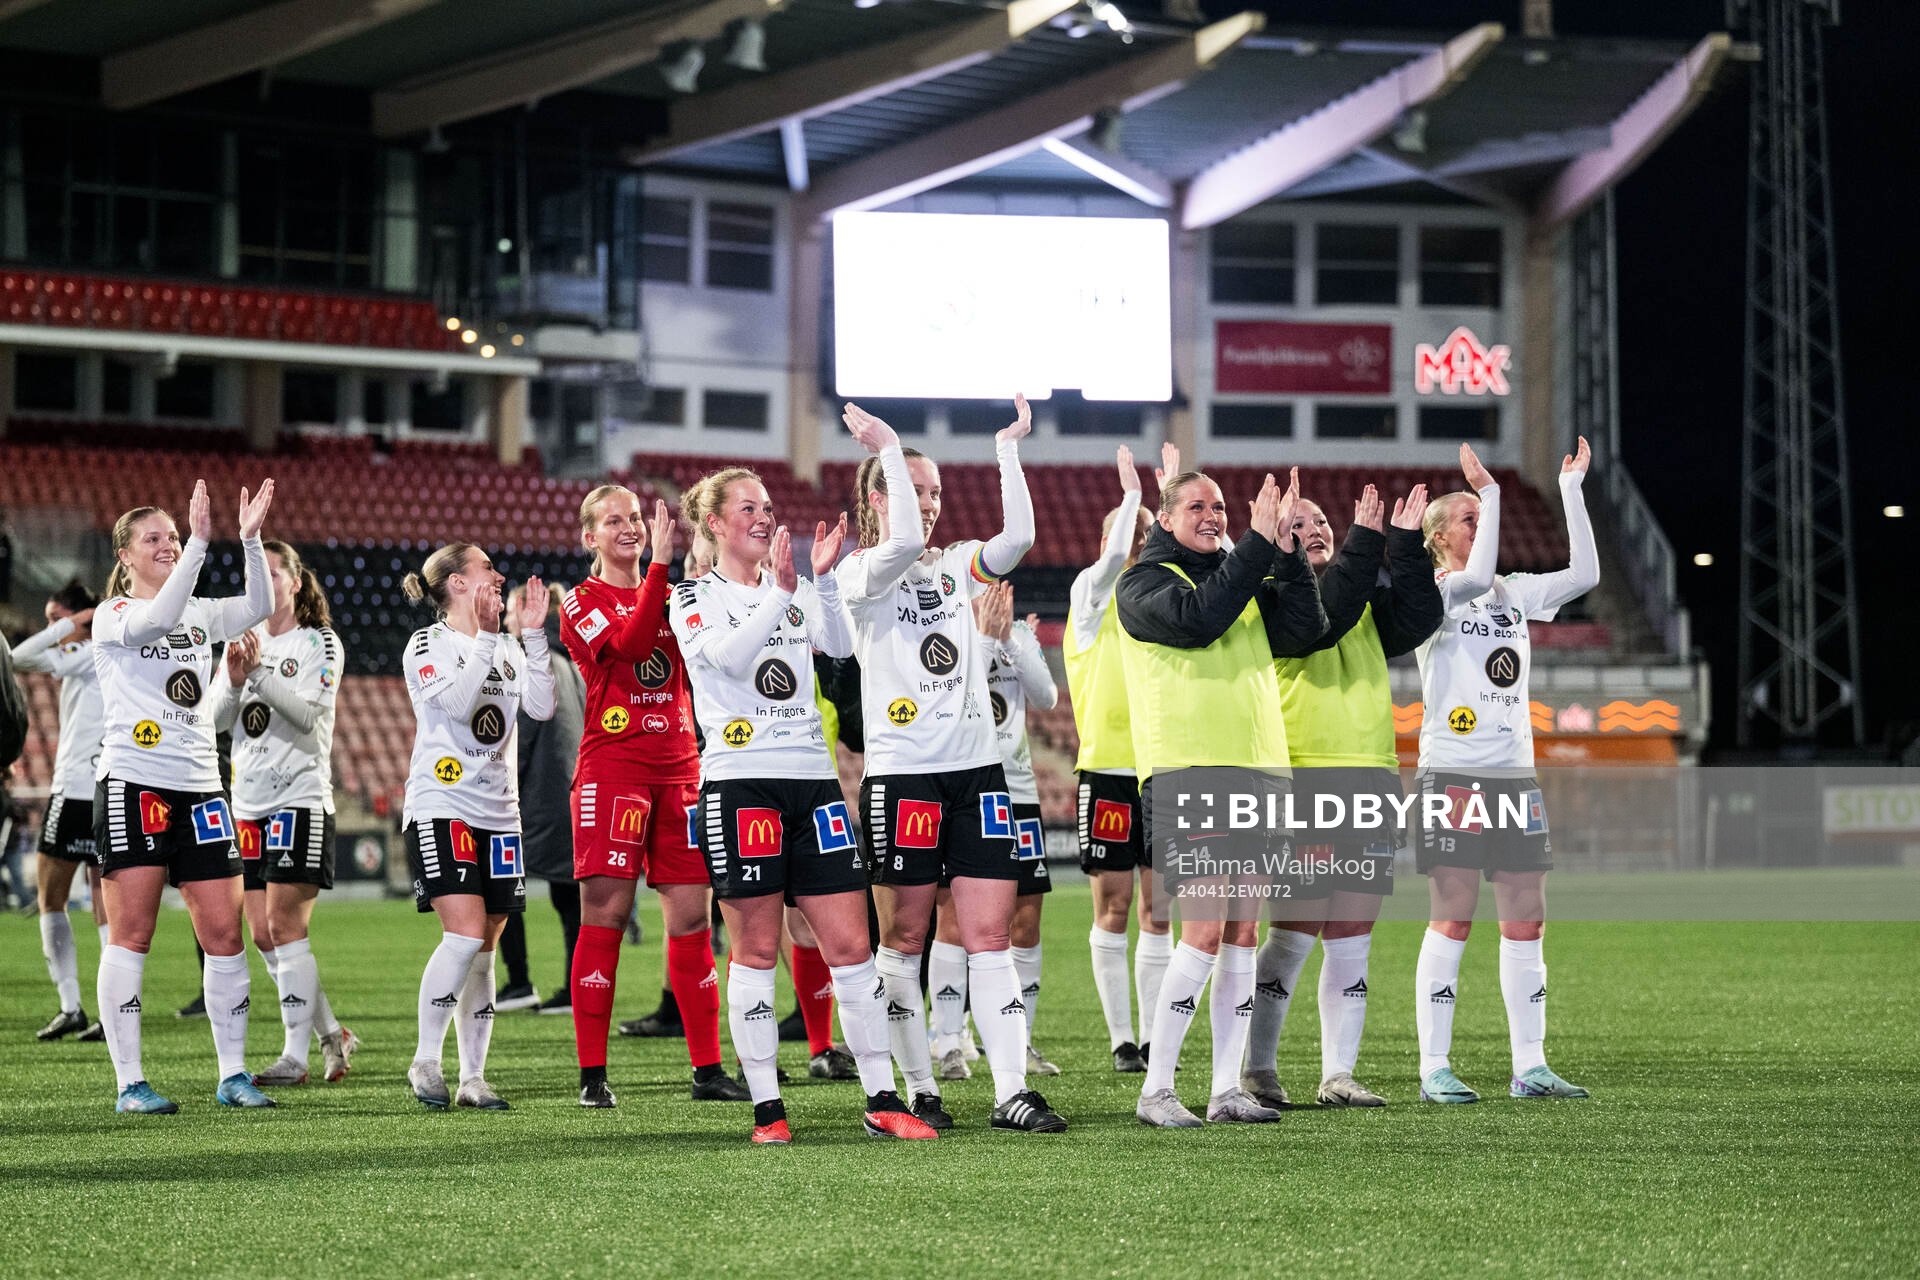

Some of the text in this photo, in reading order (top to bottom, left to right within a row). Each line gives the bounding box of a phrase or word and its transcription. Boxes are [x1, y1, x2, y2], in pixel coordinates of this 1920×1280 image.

[1415, 325, 1511, 395] MAX
[920, 681, 930, 693] In
[630, 692, 640, 704] In
[1480, 691, 1489, 703] In
[162, 709, 173, 721] In
[756, 705, 806, 719] In Frigore
[465, 747, 475, 758] In
[145, 837, 155, 850] 3
[1438, 837, 1456, 852] 13
[607, 851, 627, 867] 26
[1090, 845, 1106, 859] 10
[893, 855, 904, 871] 8
[456, 868, 467, 882] 7
[742, 865, 761, 882] 21
